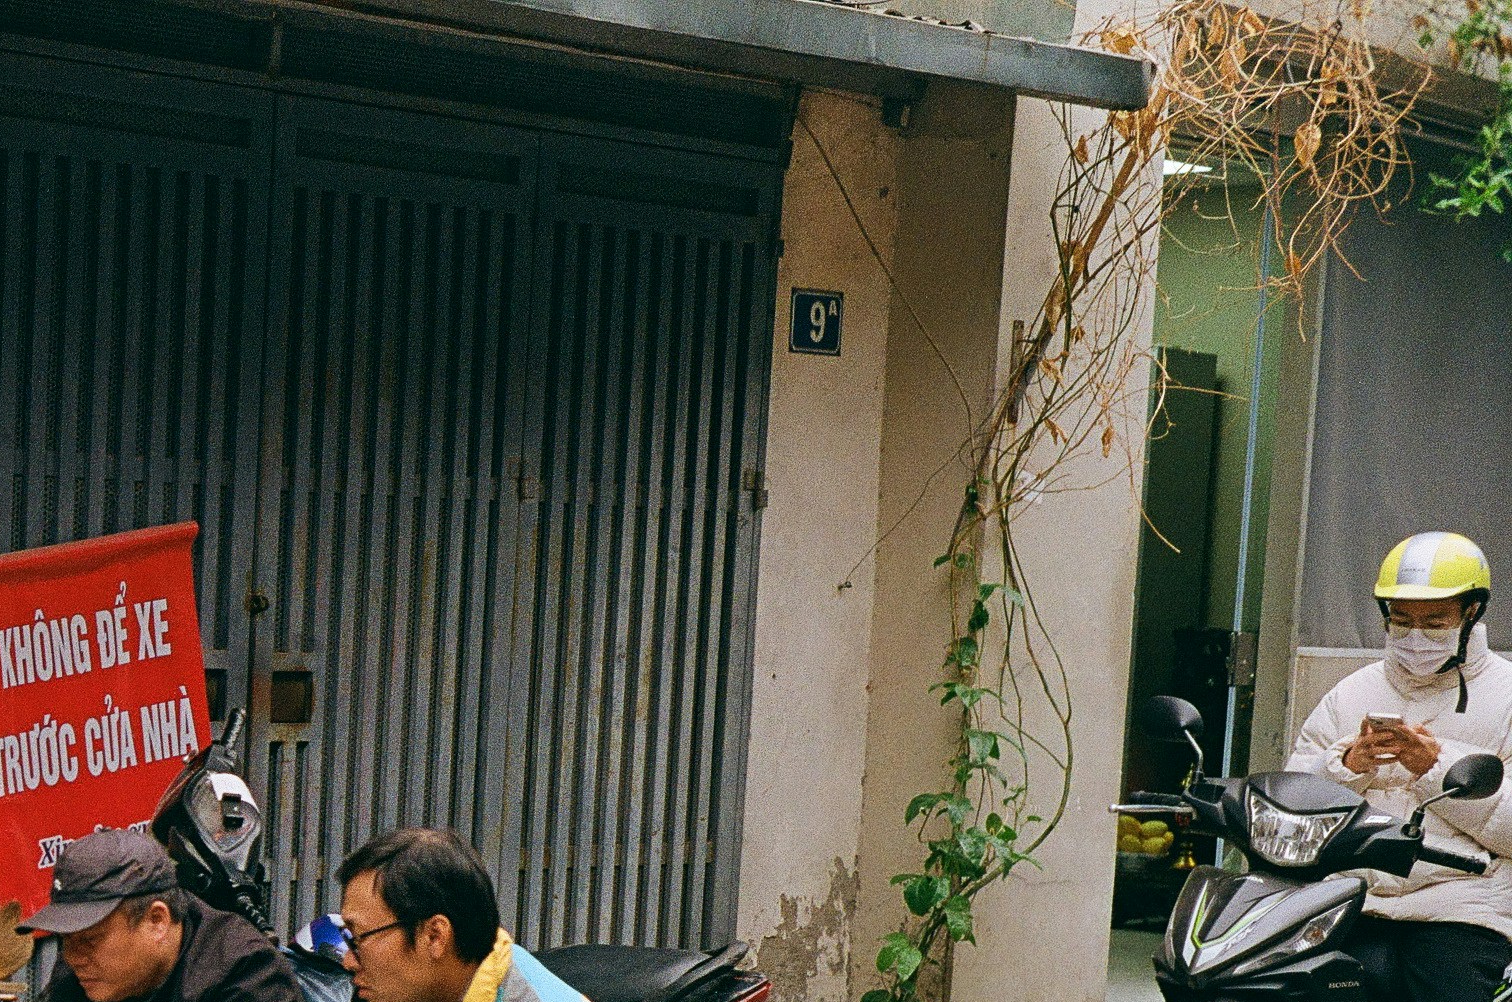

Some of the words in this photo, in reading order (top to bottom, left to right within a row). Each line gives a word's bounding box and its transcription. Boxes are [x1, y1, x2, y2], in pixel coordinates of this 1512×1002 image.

[95, 580, 131, 670] ĐỂ
[135, 598, 172, 661] XE
[84, 694, 137, 777] CỬA
[142, 685, 199, 764] NHÀ
[1328, 980, 1360, 989] HONDA
